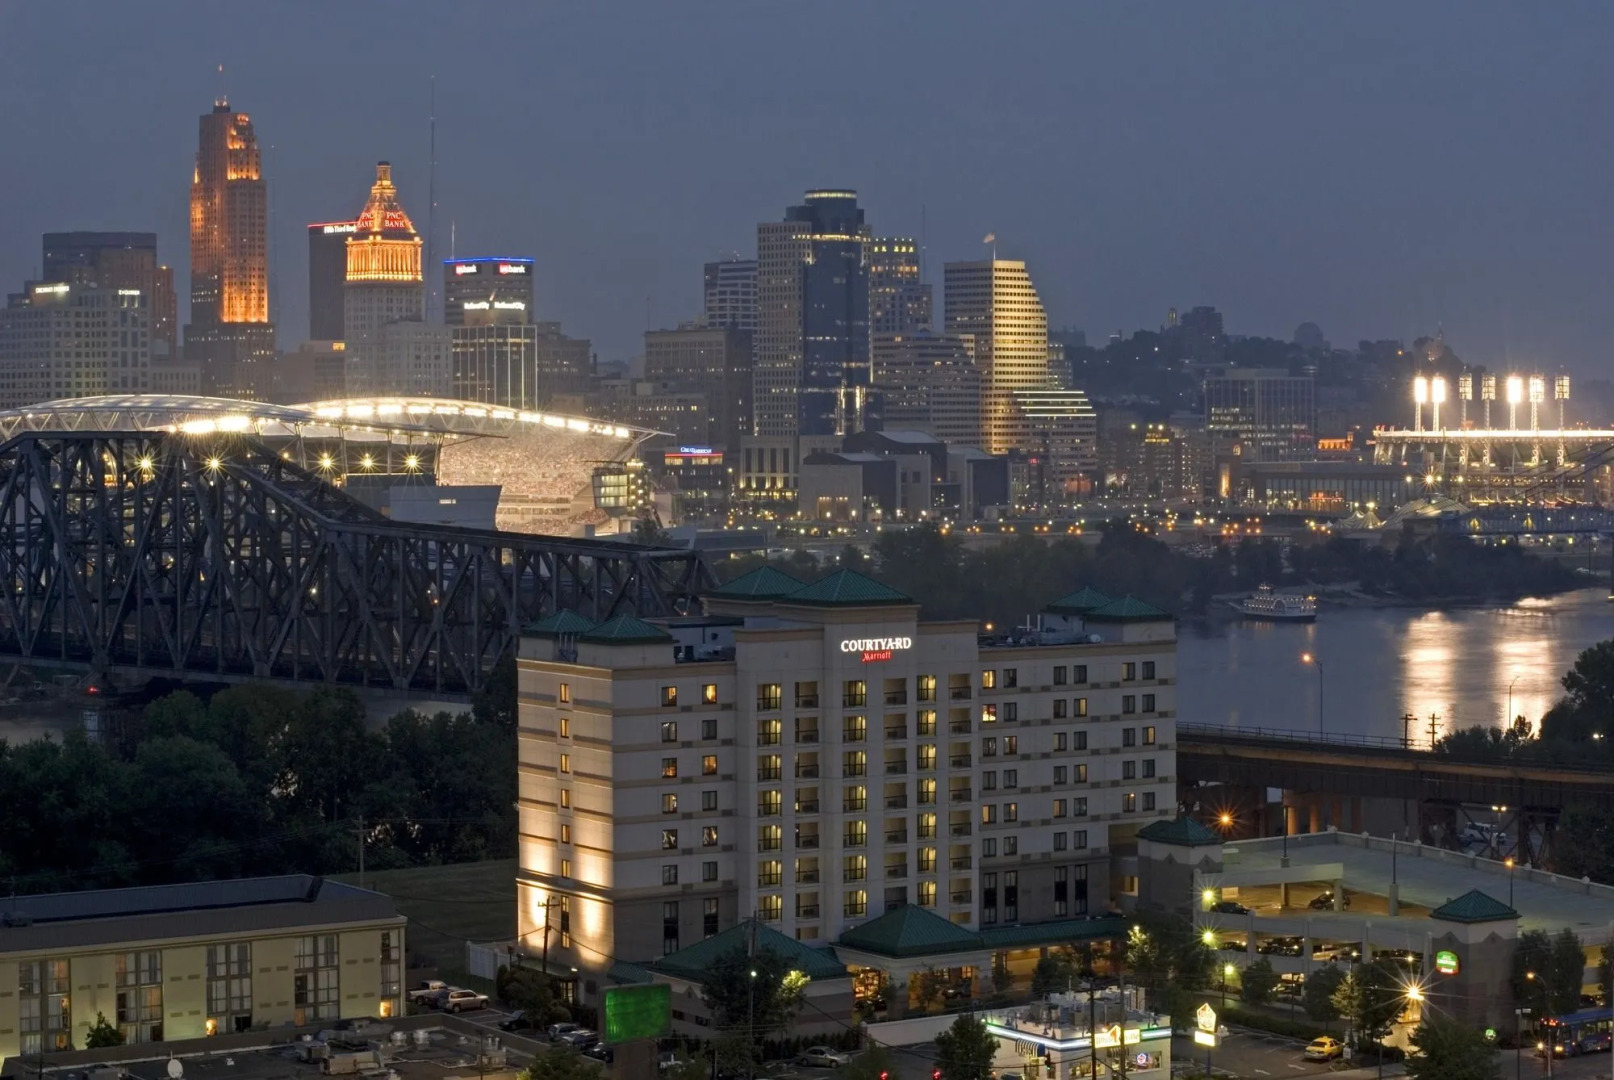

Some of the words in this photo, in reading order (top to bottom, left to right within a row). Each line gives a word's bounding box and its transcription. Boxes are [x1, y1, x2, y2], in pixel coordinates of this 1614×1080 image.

[384, 220, 405, 228] BANK
[840, 637, 912, 652] COURTYARD
[862, 650, 891, 662] Marriott
